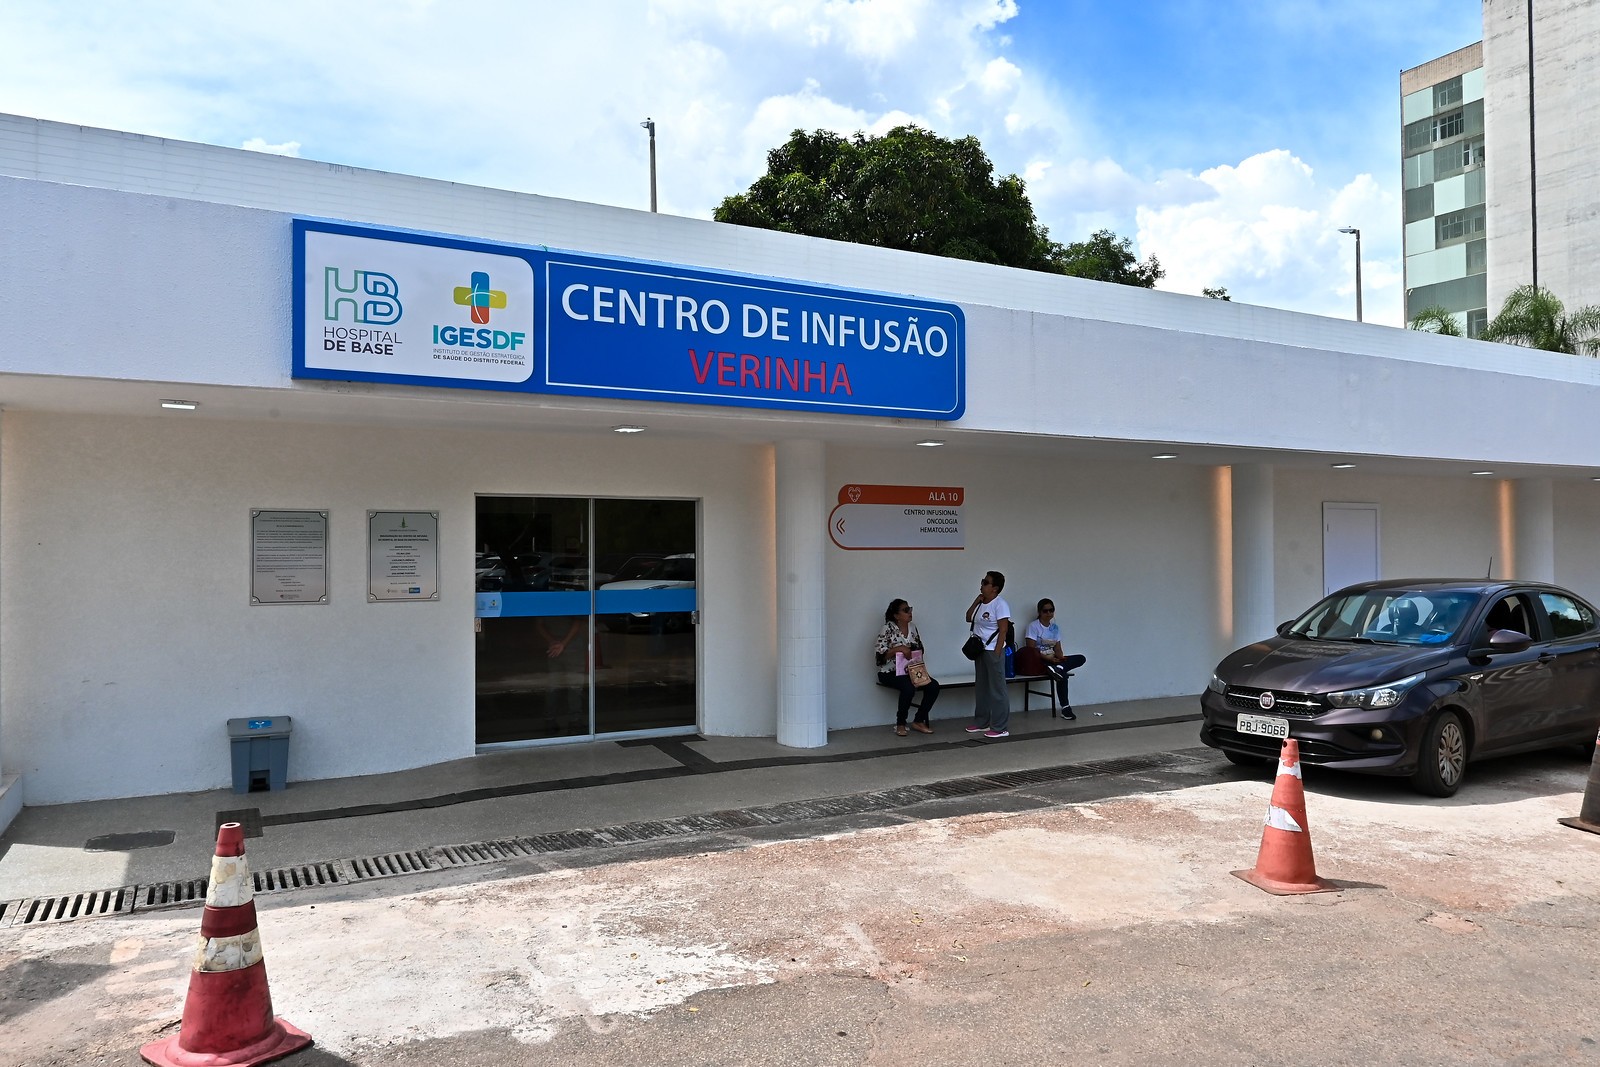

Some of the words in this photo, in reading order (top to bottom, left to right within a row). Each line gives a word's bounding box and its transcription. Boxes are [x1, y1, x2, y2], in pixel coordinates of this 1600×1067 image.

[561, 283, 730, 335] CENTRO
[742, 304, 790, 342] DE
[801, 310, 949, 358] INFUSÃO
[324, 326, 403, 344] HOSPITAL
[433, 325, 525, 350] IGESDF
[324, 340, 346, 353] DE
[351, 342, 394, 356] BASE
[687, 349, 853, 396] VERINHA
[928, 492, 946, 501] ALA
[949, 493, 958, 501] 10
